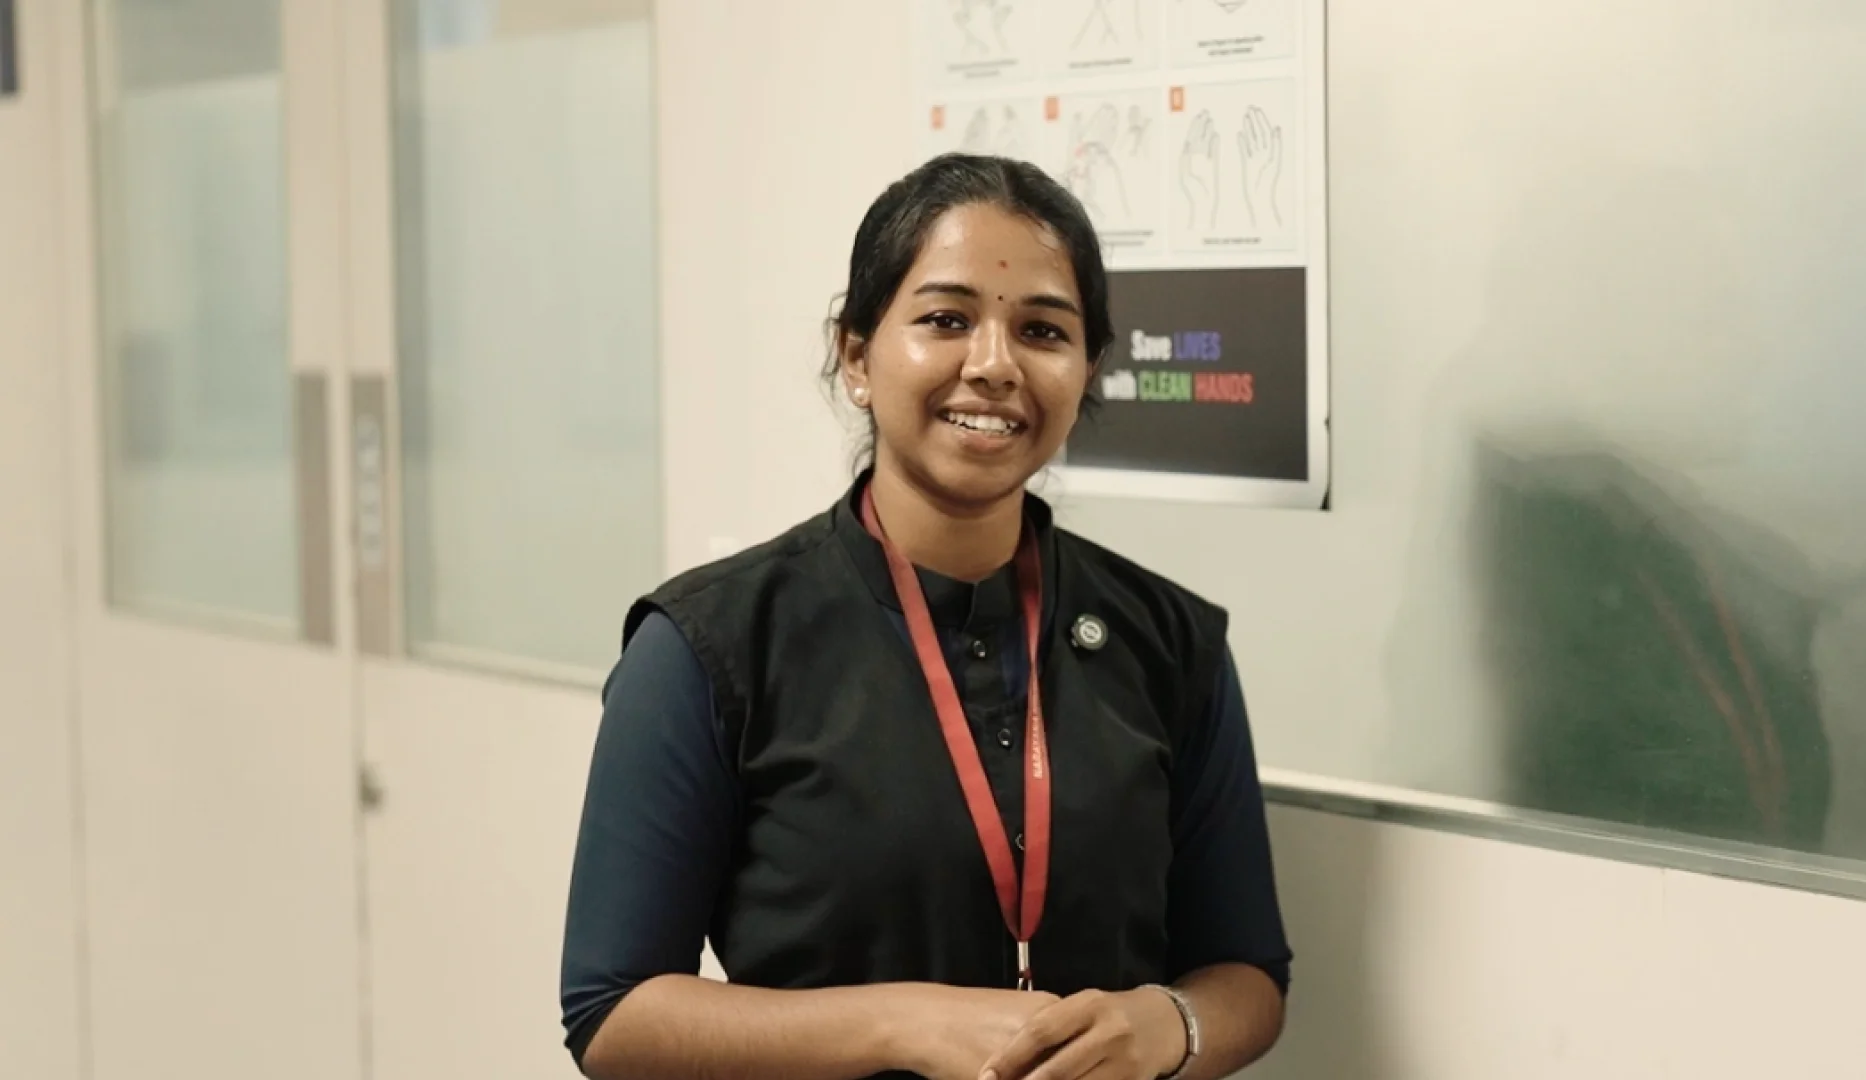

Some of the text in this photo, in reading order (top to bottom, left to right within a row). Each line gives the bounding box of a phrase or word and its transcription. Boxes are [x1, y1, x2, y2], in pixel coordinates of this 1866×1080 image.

[1131, 329, 1222, 361] Save LIVES
[1102, 369, 1254, 403] with CLEAN HANDS
